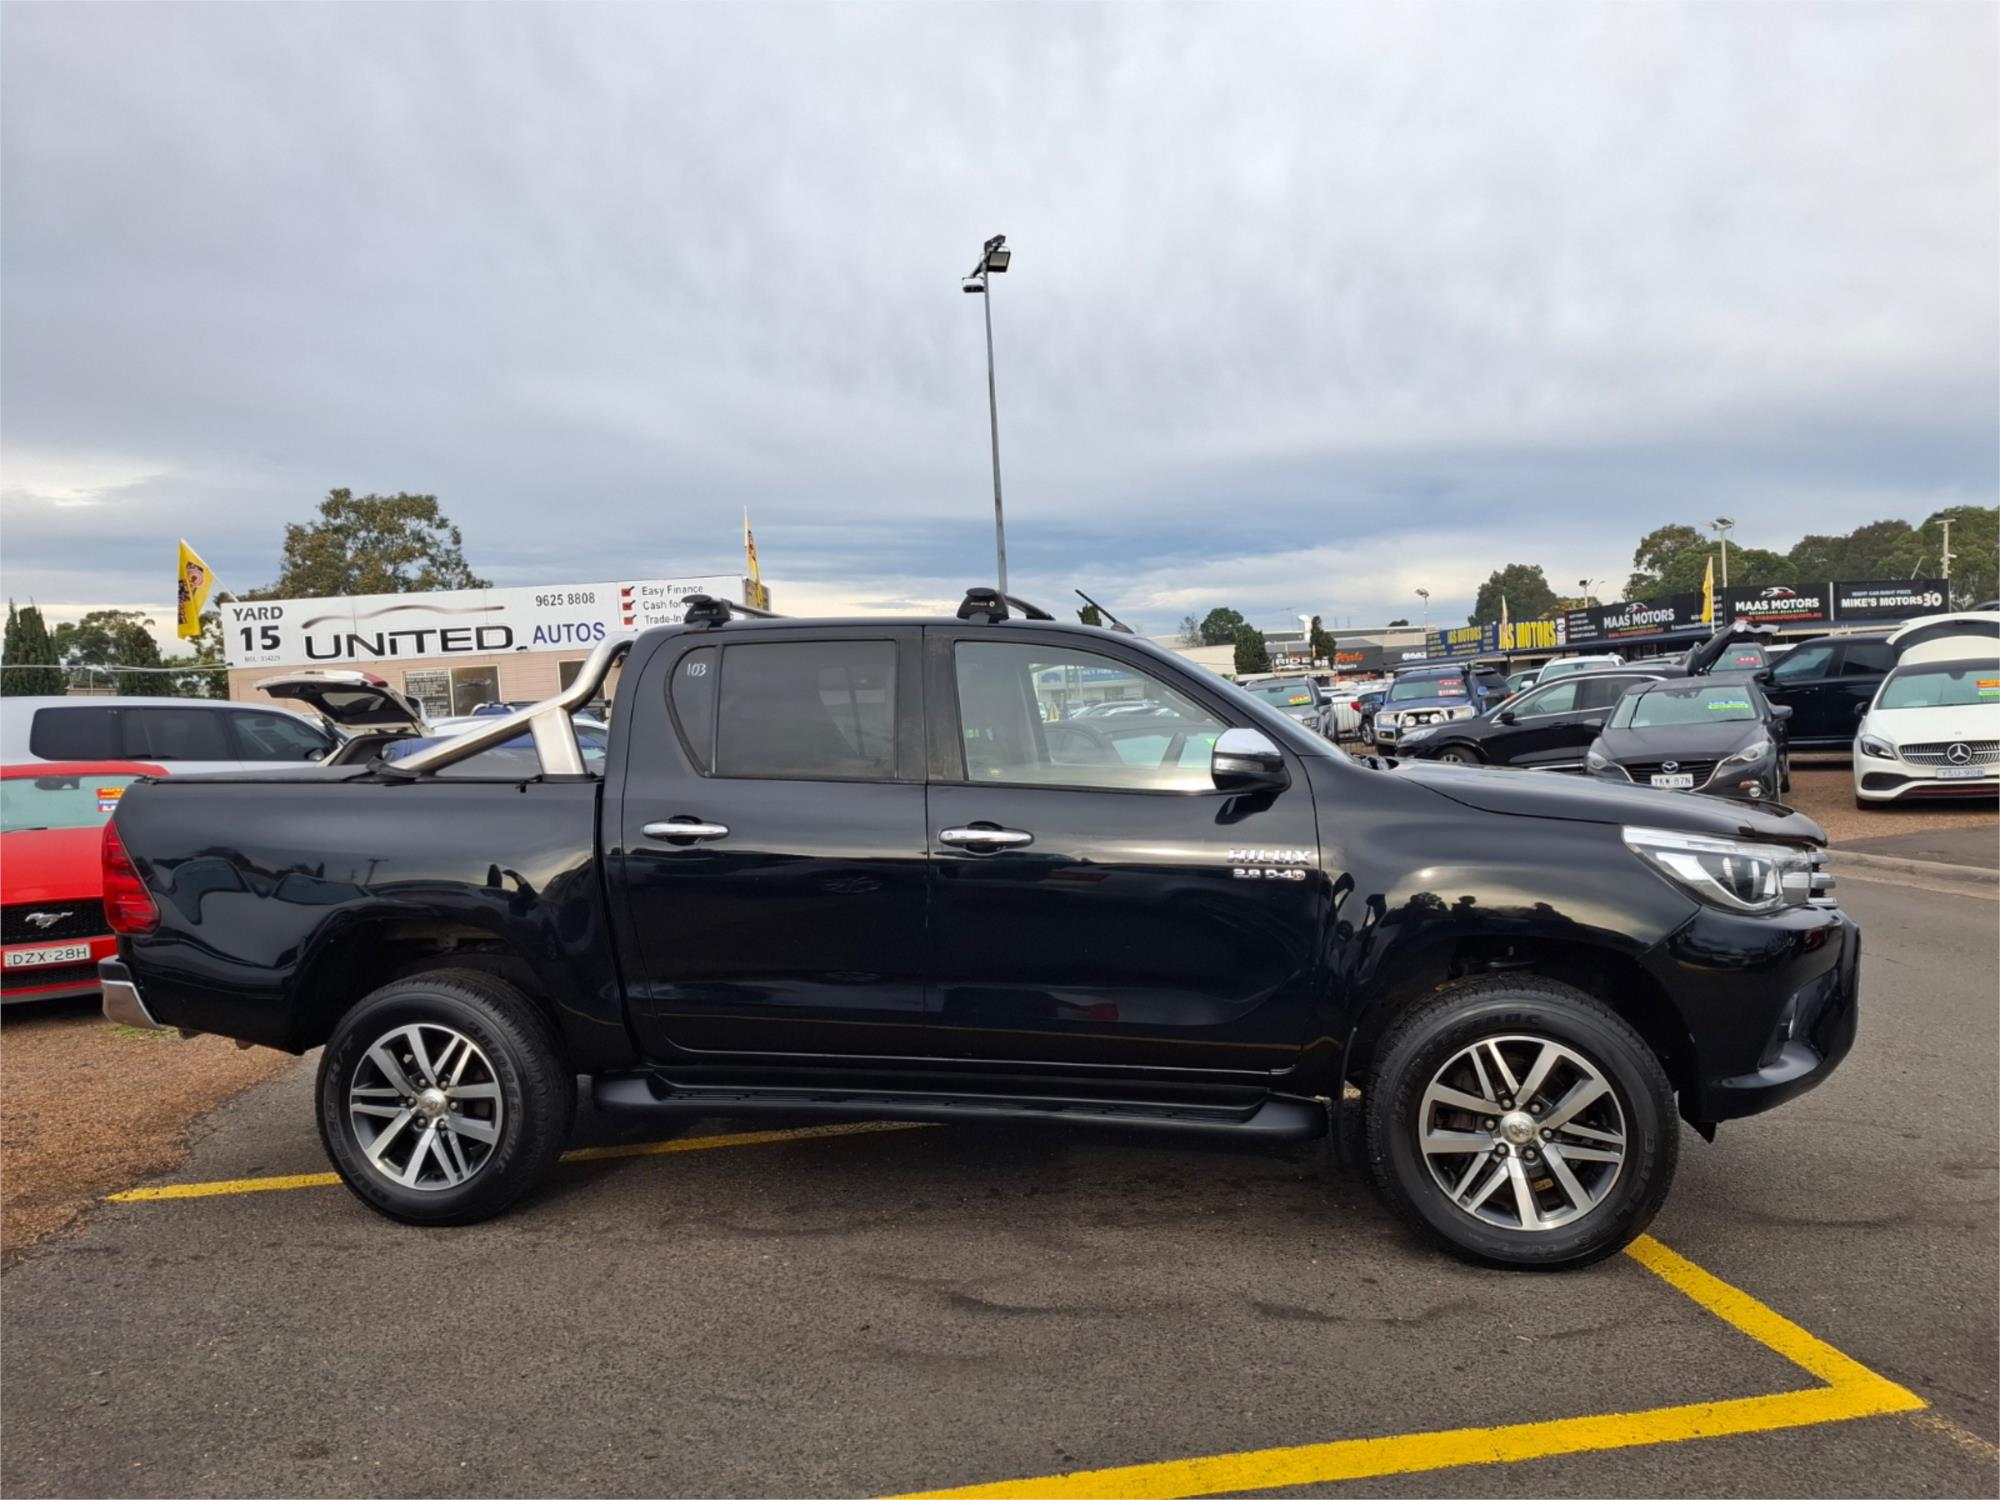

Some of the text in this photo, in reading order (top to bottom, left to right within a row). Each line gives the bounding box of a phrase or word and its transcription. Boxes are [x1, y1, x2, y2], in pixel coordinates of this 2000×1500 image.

[641, 584, 704, 597] Easy Finance
[535, 591, 596, 607] 9625 8808
[643, 600, 667, 610] Cash
[1735, 600, 1769, 612] MAAS
[1771, 597, 1820, 610] MOTORS
[1841, 595, 1922, 608] MIKE'S MOTORS
[1923, 591, 1943, 607] 30
[232, 605, 284, 621] YARD
[1603, 614, 1631, 630] MAAS
[1632, 608, 1676, 625] MOTORS
[239, 624, 281, 652] 15
[533, 621, 606, 645] AUTOS
[1516, 619, 1557, 649] MOTORS
[687, 663, 707, 677] 103
